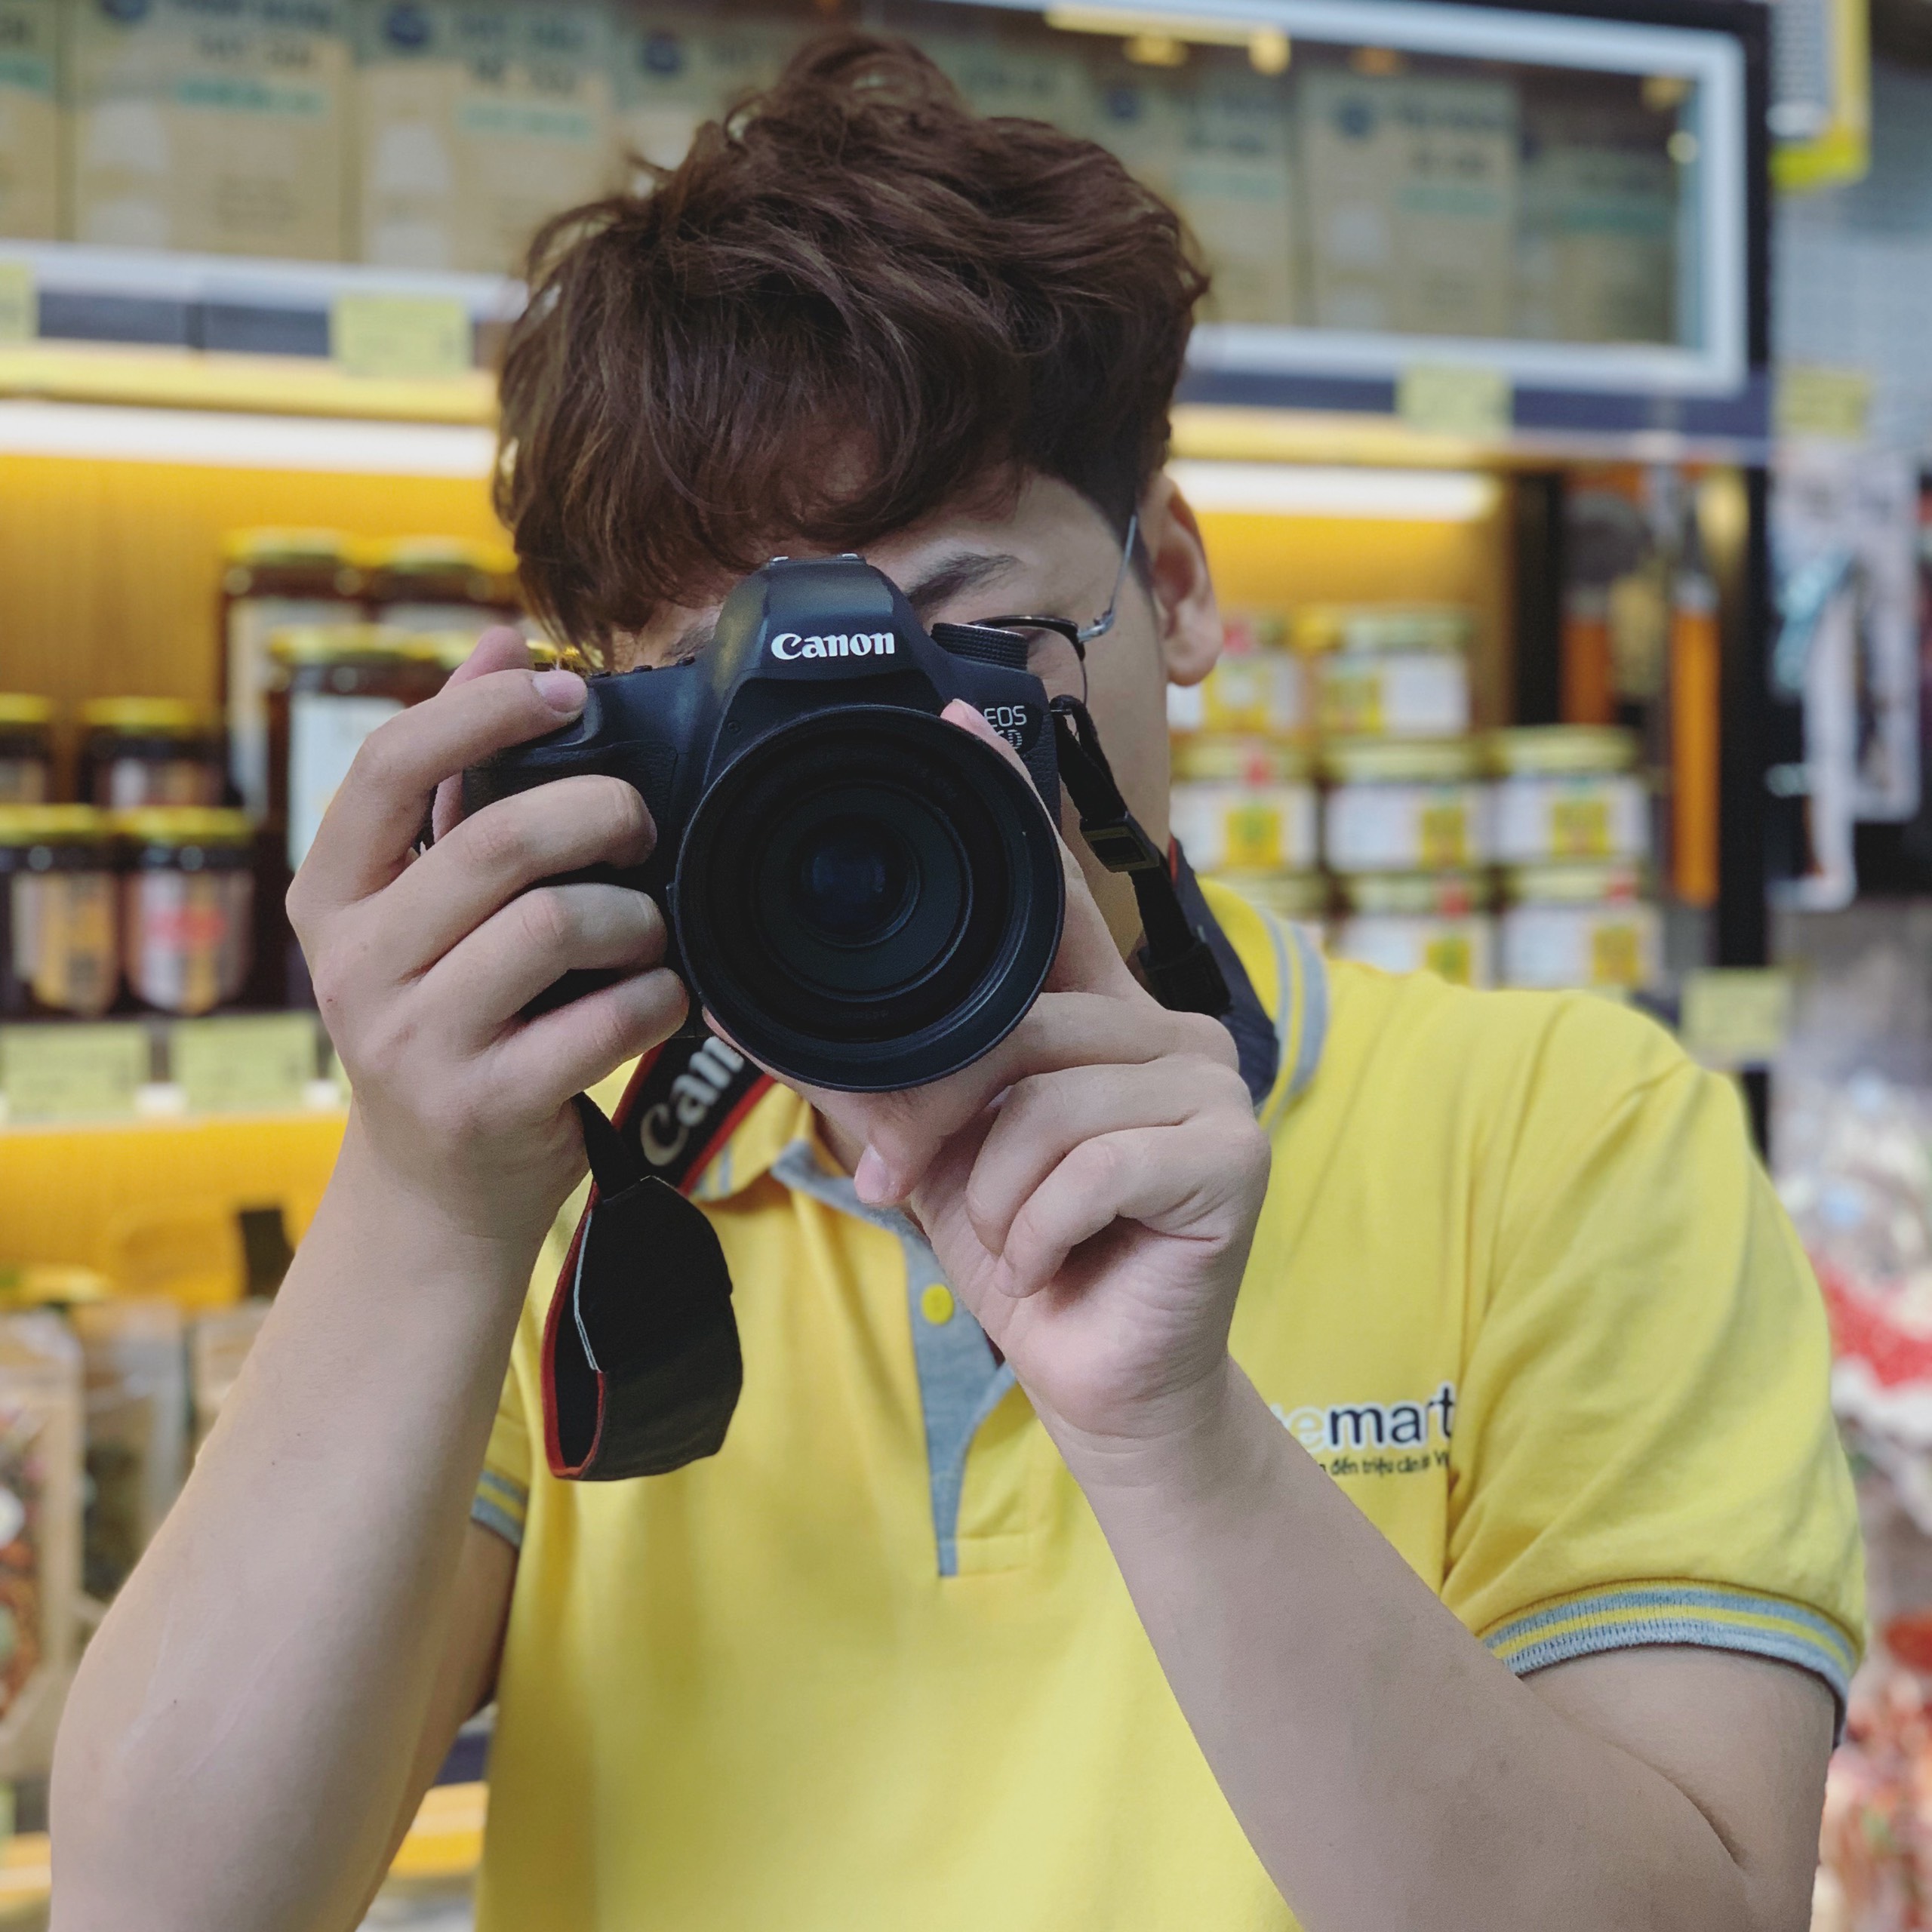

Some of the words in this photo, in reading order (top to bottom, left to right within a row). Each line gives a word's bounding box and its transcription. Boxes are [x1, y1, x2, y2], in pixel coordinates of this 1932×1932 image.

[771, 632, 895, 660] Canon
[983, 706, 1027, 728] EOS
[996, 729, 1023, 749] D
[1271, 1386, 1454, 1453] emart
